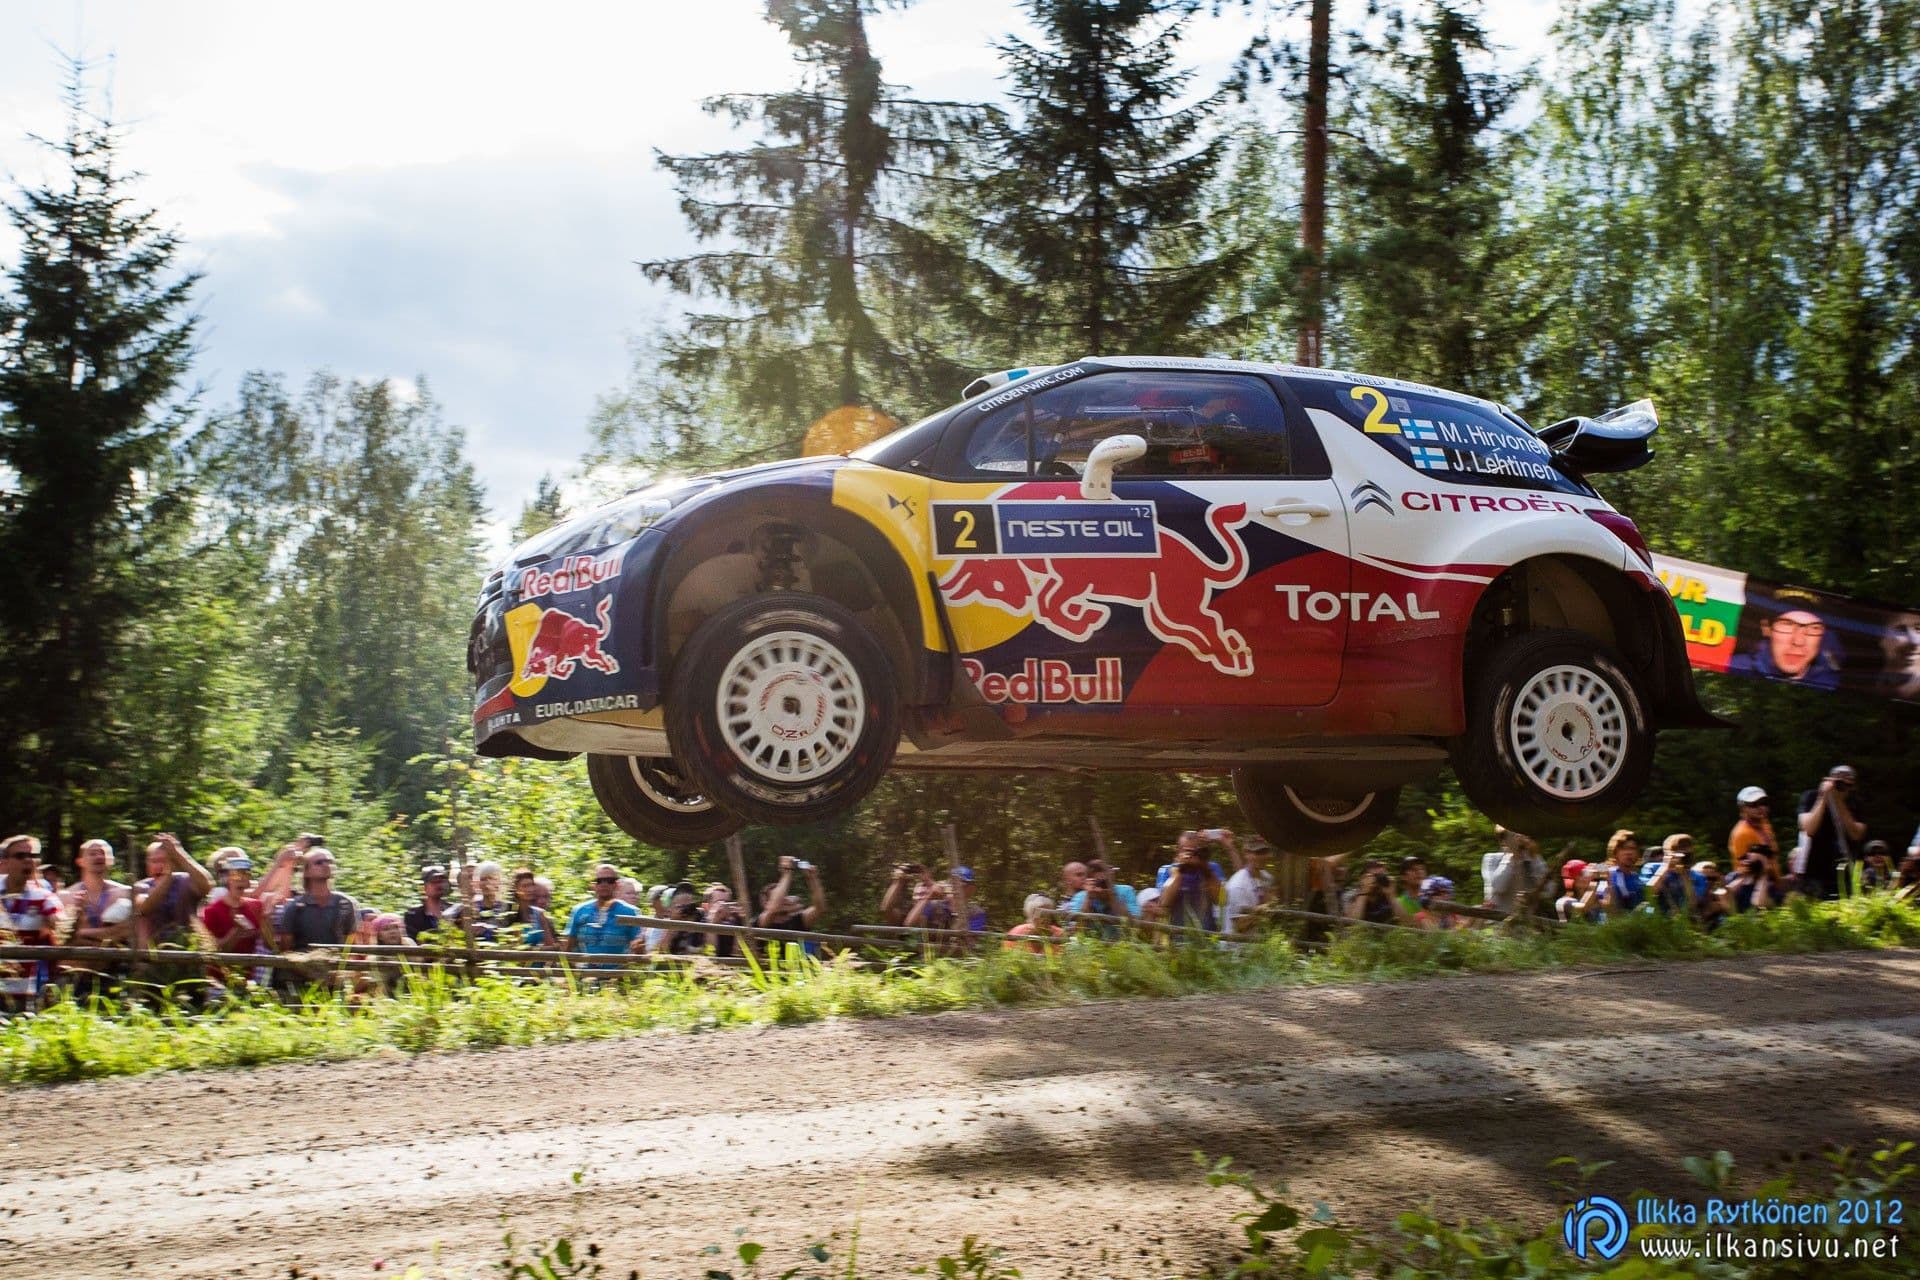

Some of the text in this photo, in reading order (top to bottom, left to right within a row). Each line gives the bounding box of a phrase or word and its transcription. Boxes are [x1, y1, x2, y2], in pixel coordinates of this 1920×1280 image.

[1350, 386, 1402, 434] 2
[1437, 421, 1553, 458] M. Hirvonen
[1453, 449, 1558, 481] J. Lehtinen
[1401, 491, 1582, 514] CITROËN
[953, 510, 977, 548] 2
[1007, 520, 1144, 538] NESTE OIL
[519, 554, 622, 602] Red Bull
[1275, 585, 1440, 622] TOTAL
[1041, 657, 1123, 704] Bull
